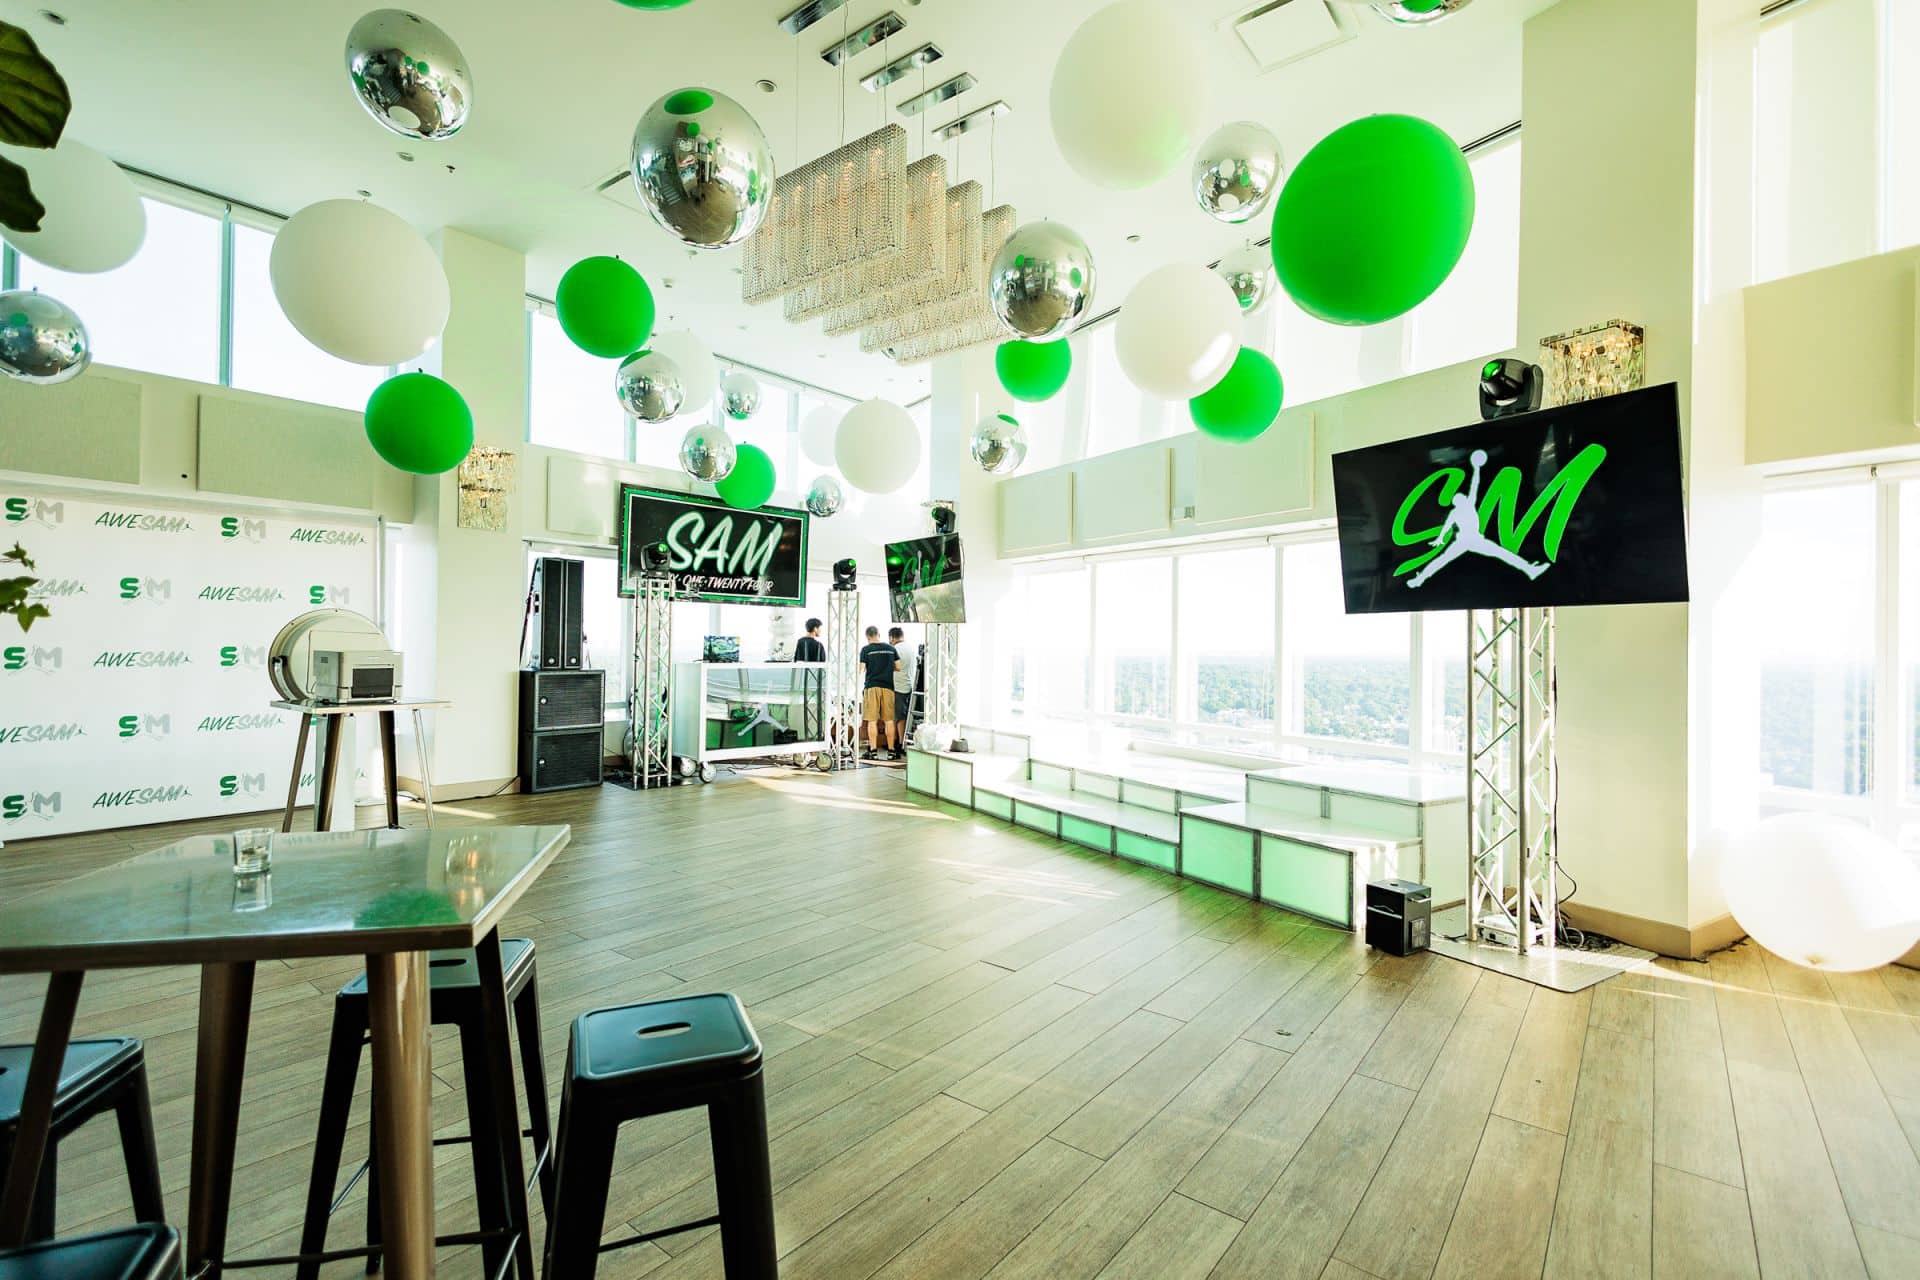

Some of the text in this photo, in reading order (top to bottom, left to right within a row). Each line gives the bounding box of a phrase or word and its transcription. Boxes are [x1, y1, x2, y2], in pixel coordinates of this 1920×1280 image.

[95, 511, 184, 532] AWESAM
[290, 528, 361, 546] AWESAM
[667, 511, 784, 575] SAM
[93, 651, 184, 668] AWESAM
[92, 784, 184, 808] AWESAM
